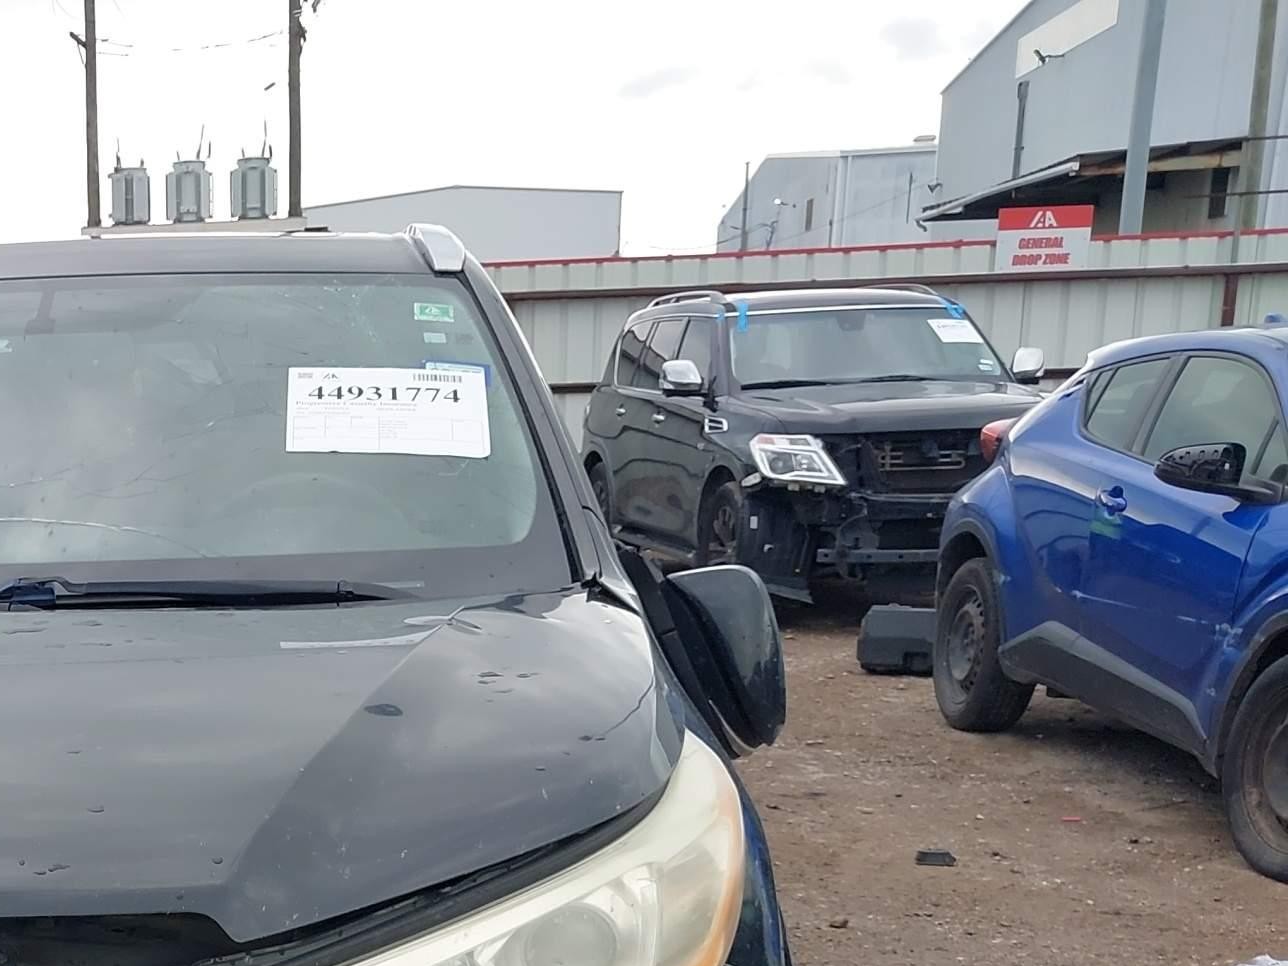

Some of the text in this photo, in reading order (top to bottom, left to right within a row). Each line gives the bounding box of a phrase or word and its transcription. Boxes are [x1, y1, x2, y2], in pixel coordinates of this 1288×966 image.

[1018, 237, 1063, 249] GENERAL
[1011, 253, 1070, 266] DROP ZONE
[308, 386, 461, 403] 44931774
